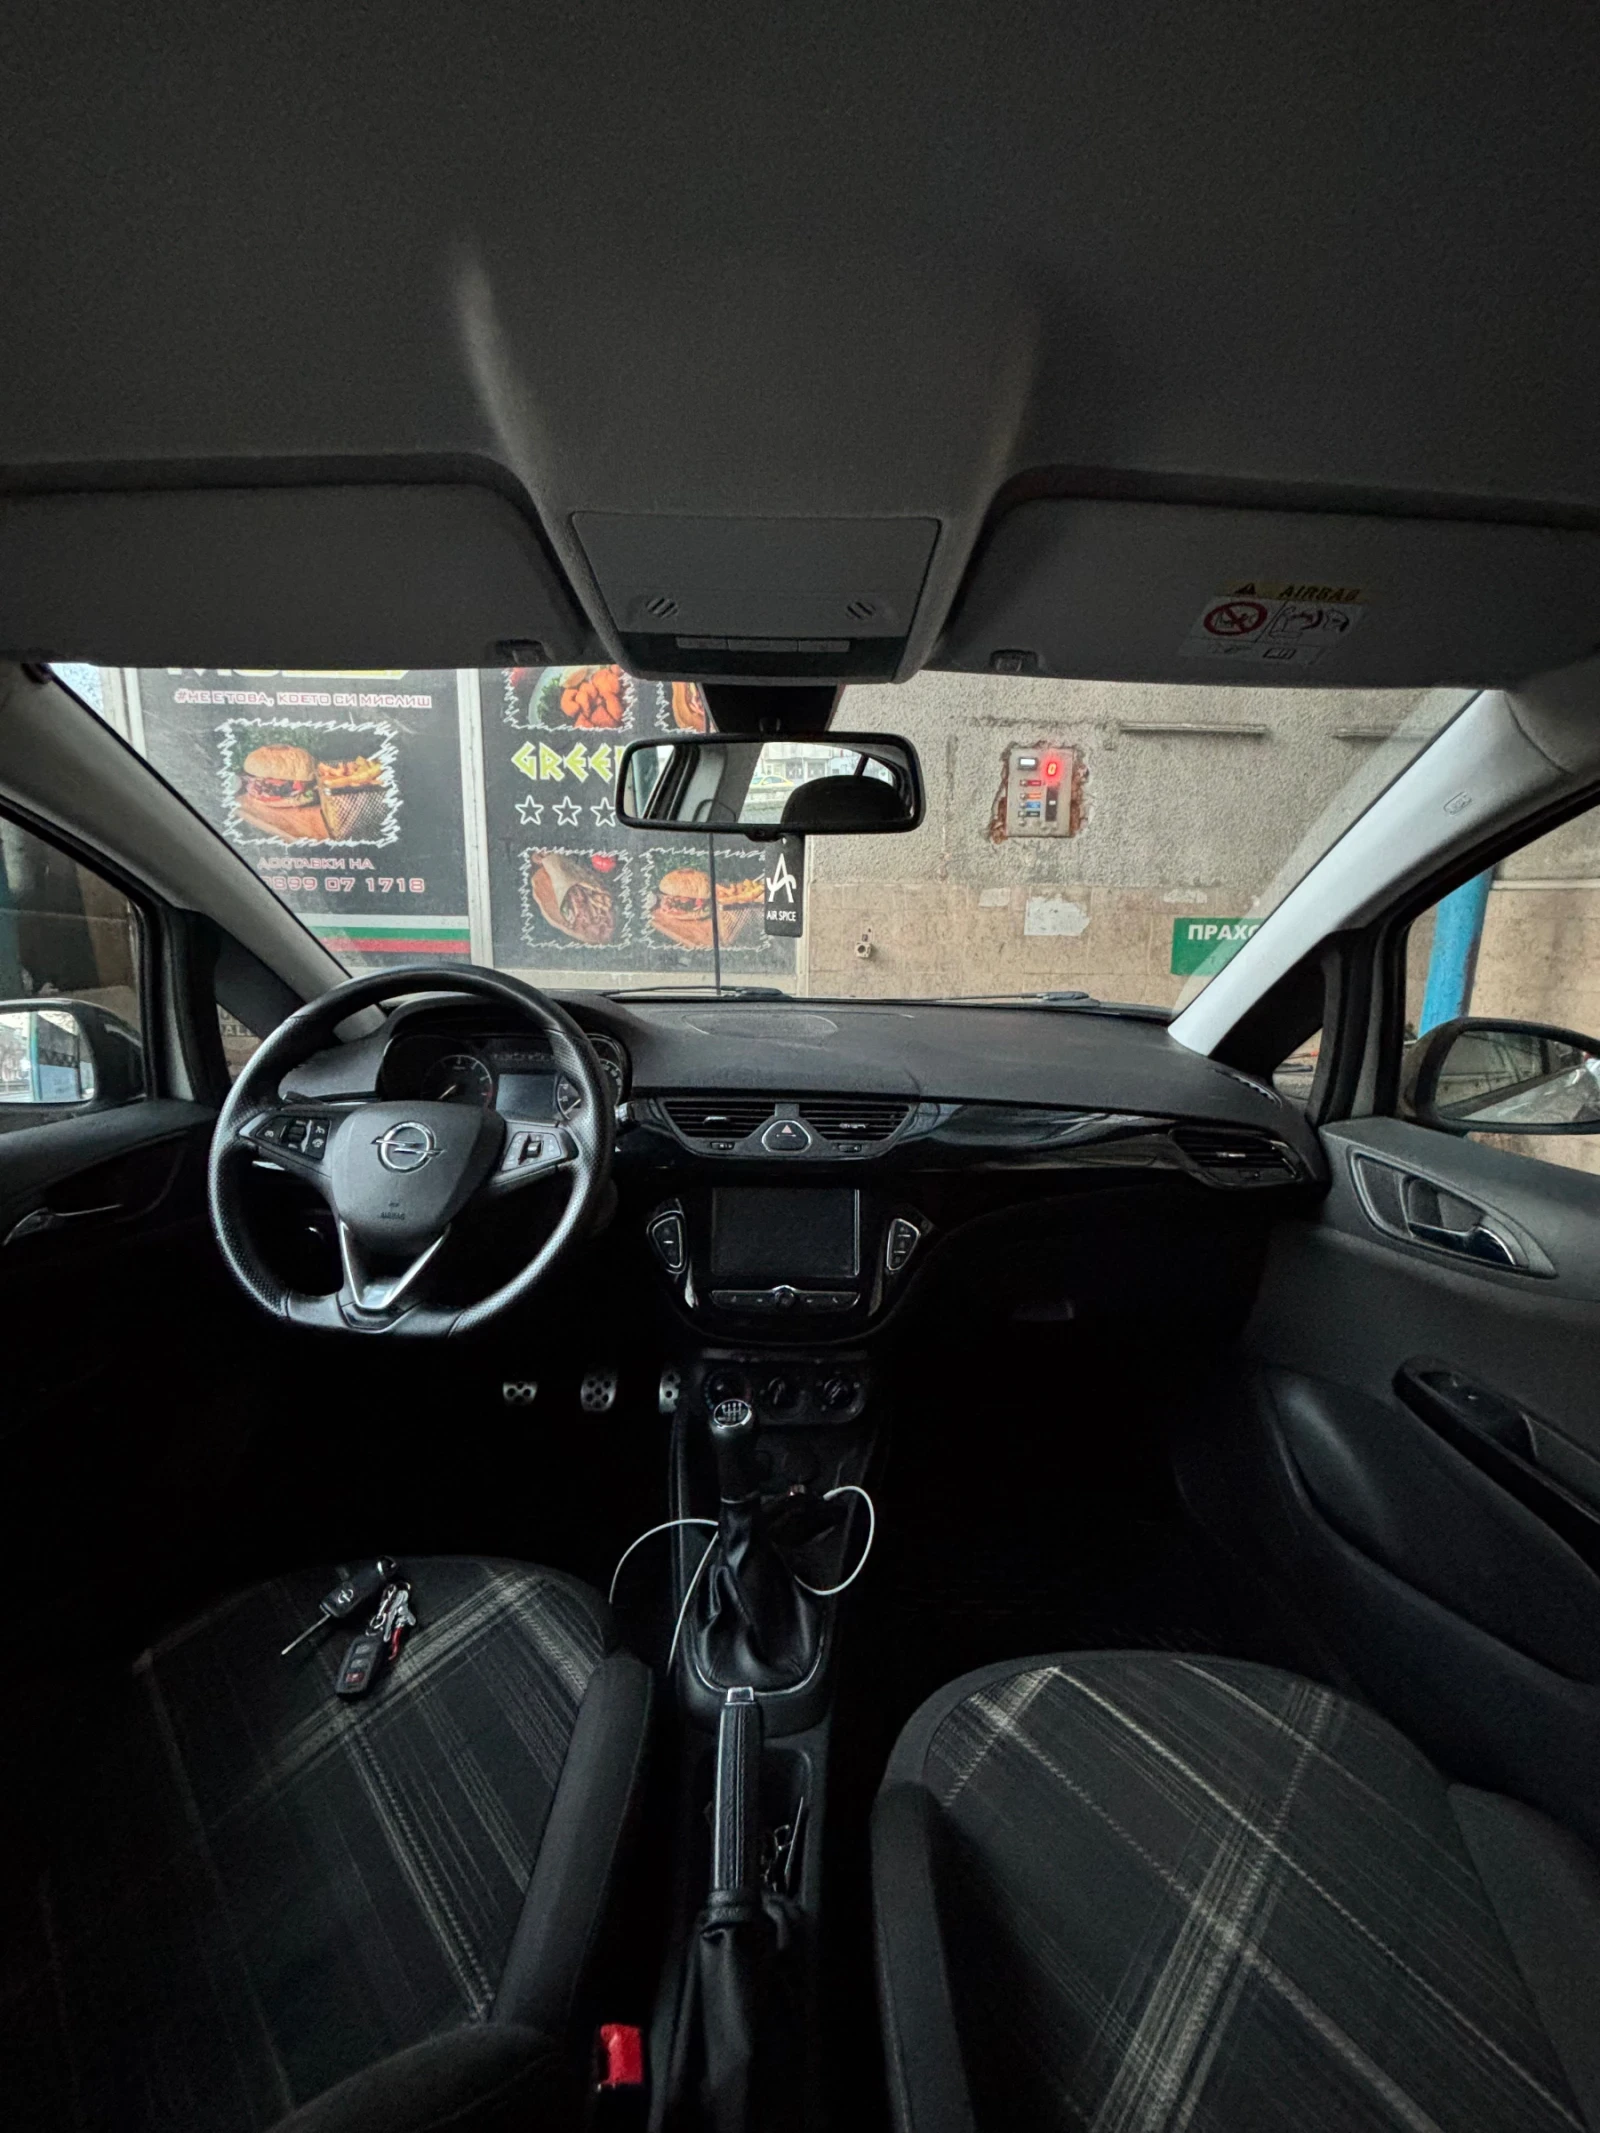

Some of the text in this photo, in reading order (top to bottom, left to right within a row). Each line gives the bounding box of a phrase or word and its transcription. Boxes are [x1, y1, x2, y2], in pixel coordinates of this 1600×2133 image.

[1278, 585, 1360, 601] AIRBAG
[277, 692, 331, 706] КОЕТО
[333, 693, 357, 707] СИ
[359, 694, 432, 708] МИСЛИШ
[257, 857, 375, 870] ДОСТАВКИ НА
[325, 877, 355, 893] 07
[365, 877, 426, 893] 1718
[766, 910, 797, 922] AIR SPICE
